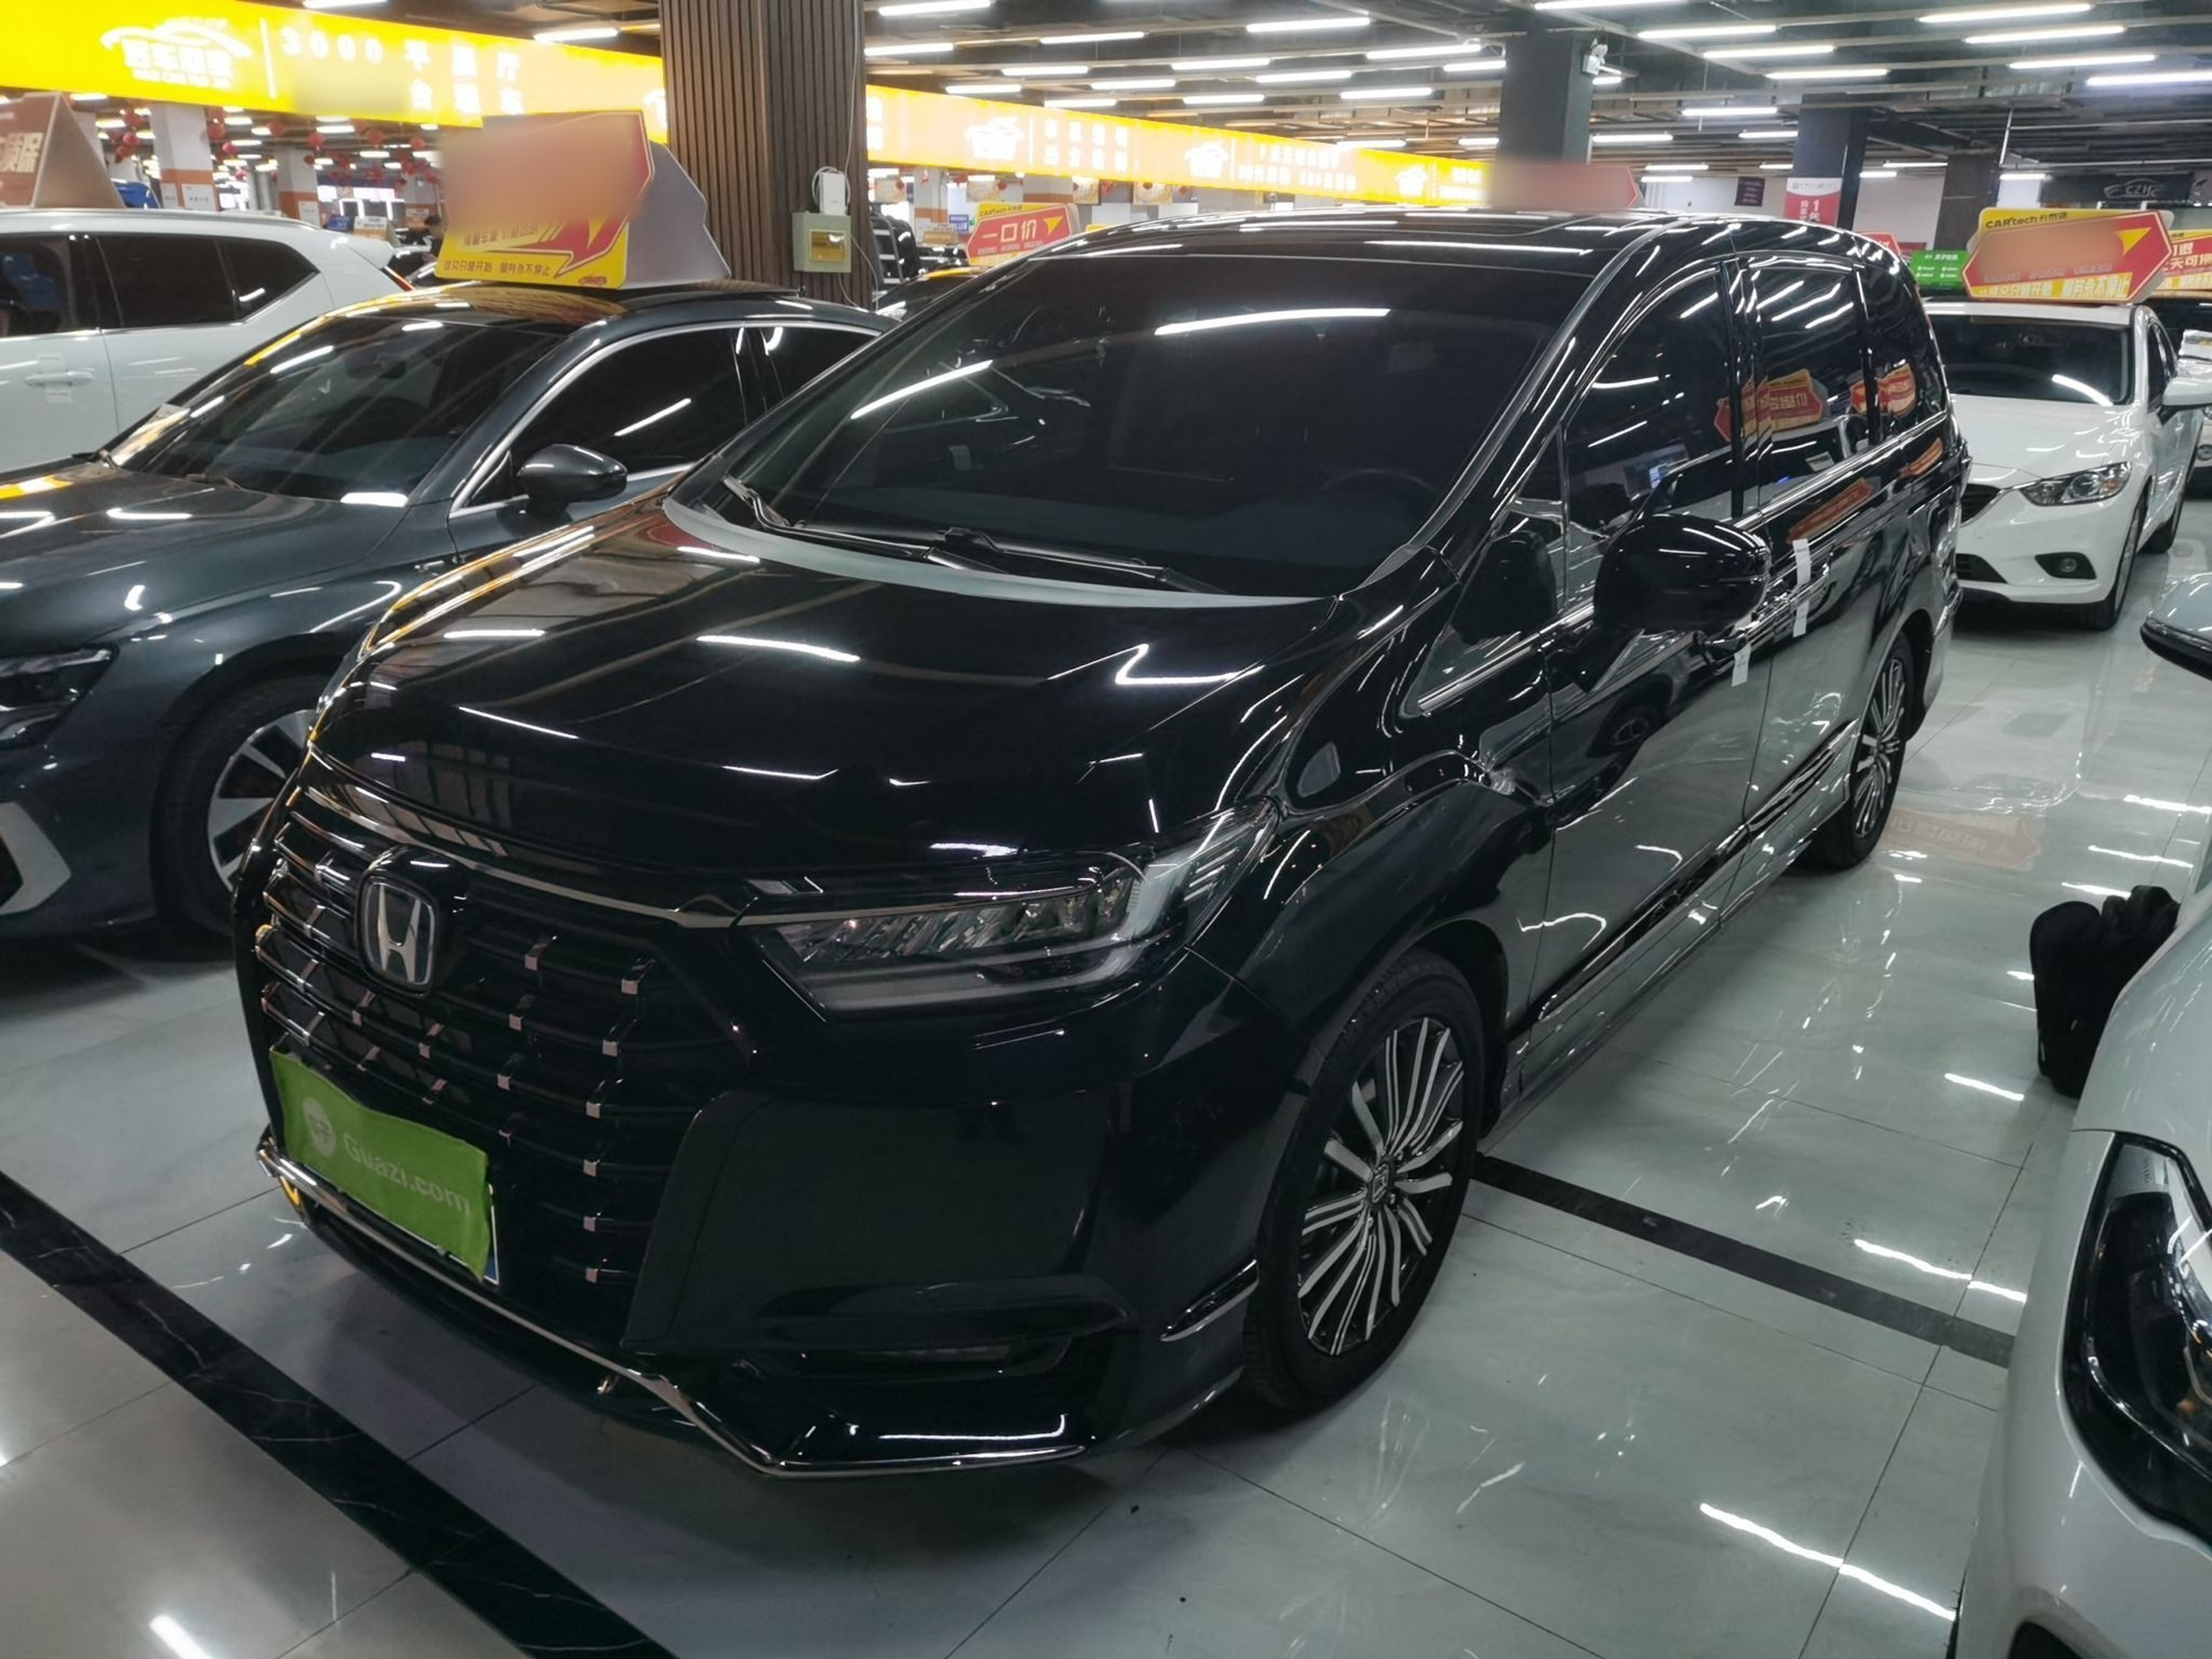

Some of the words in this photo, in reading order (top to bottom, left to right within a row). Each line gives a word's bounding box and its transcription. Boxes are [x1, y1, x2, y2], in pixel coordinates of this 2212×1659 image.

[982, 219, 1037, 243] 一口价
[343, 1131, 470, 1217] Guazi.com
